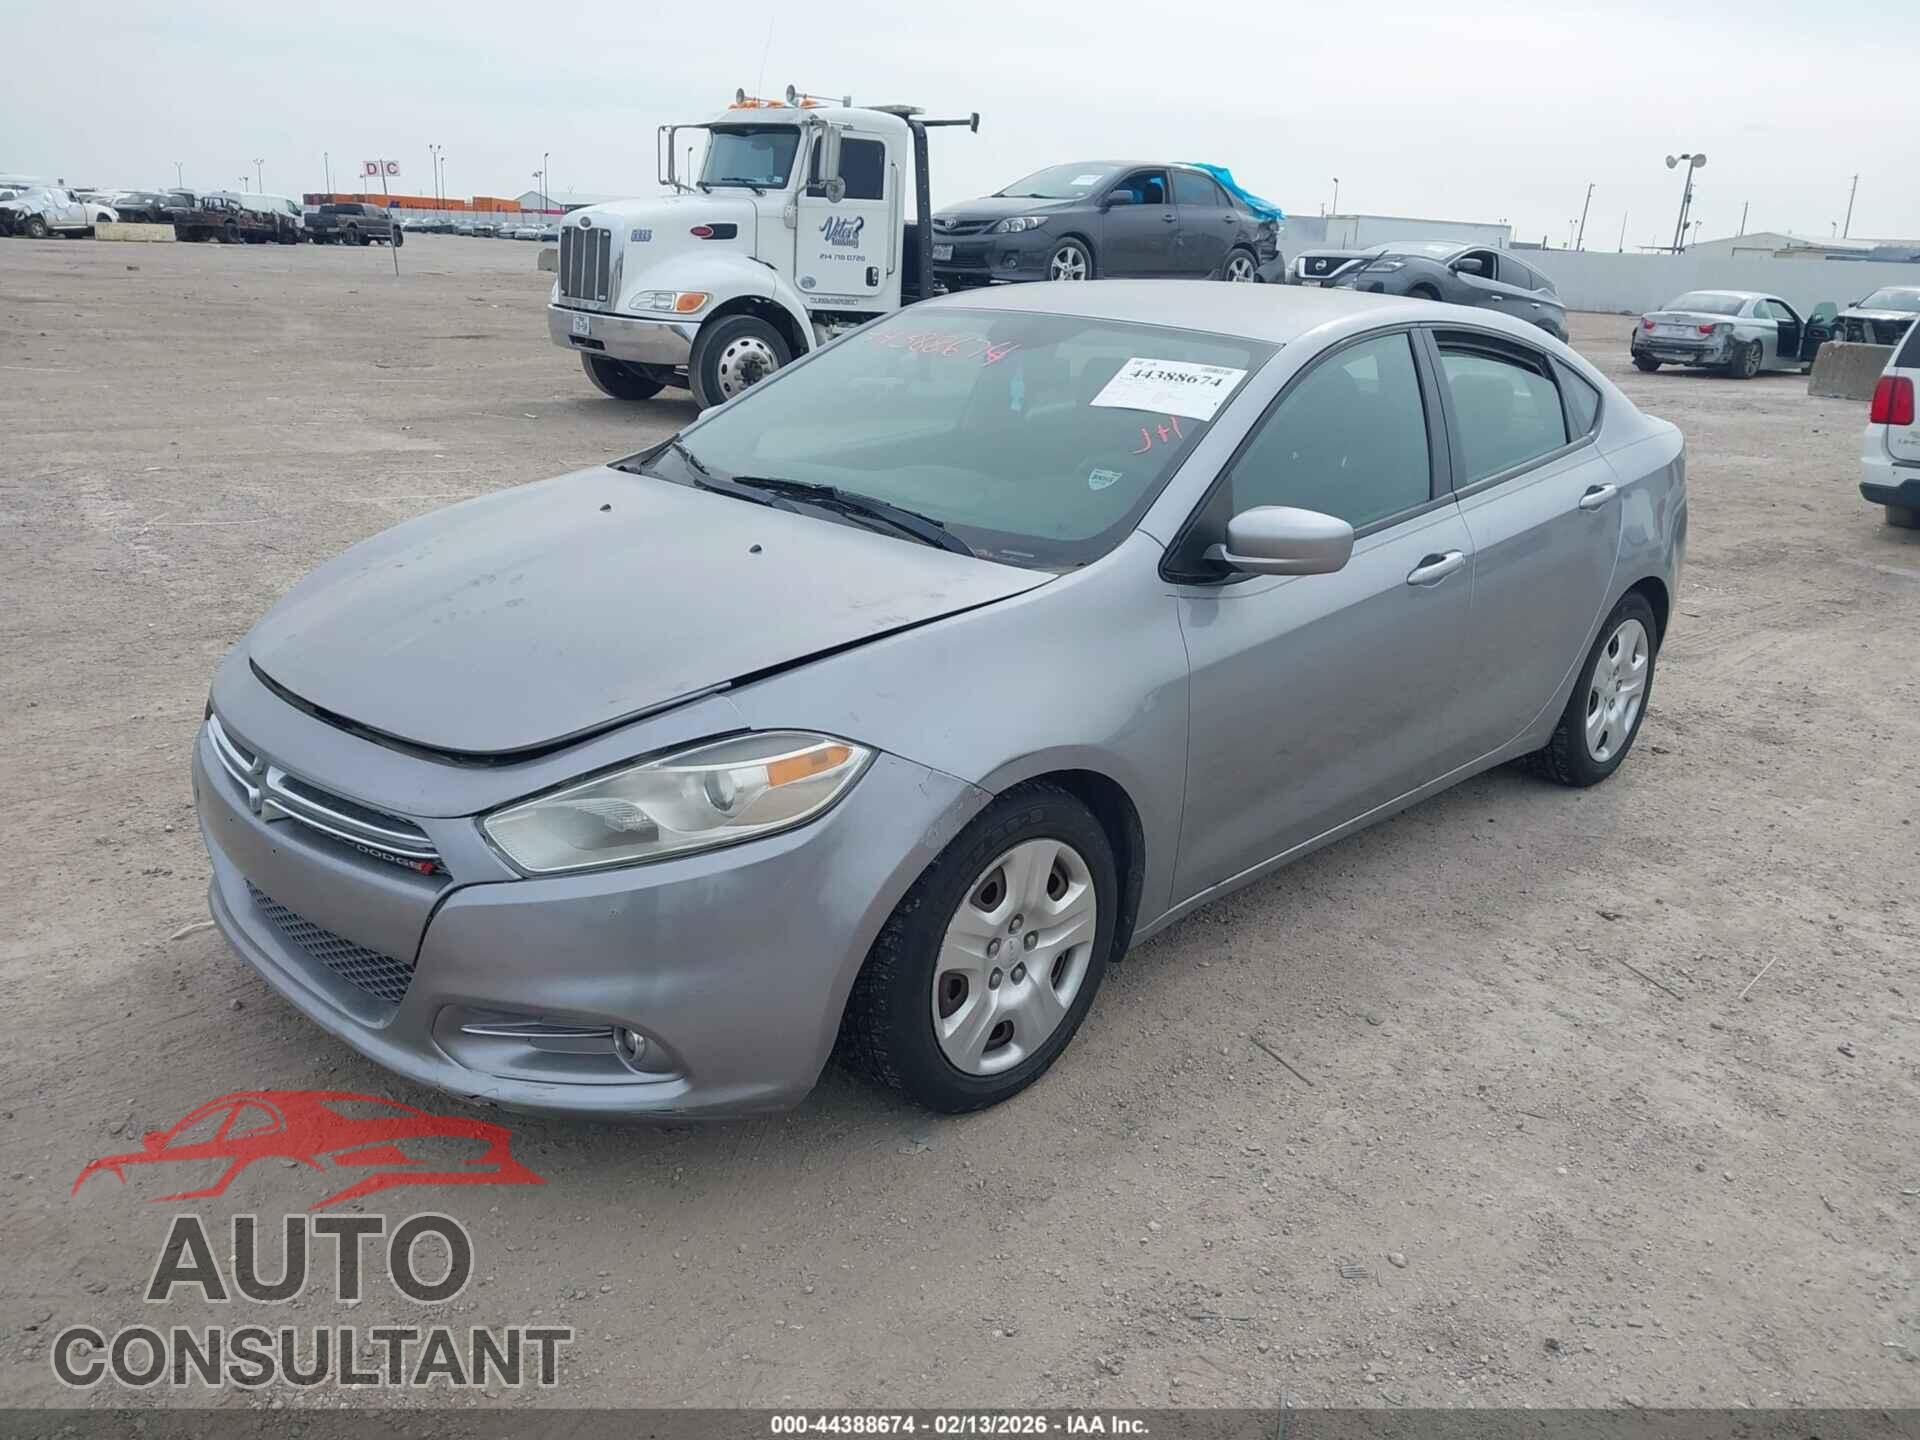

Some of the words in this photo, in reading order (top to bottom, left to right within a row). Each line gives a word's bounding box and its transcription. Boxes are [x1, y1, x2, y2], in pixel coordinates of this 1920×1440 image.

[365, 162, 377, 175] D
[386, 162, 397, 174] C
[1130, 369, 1223, 387] 44388674
